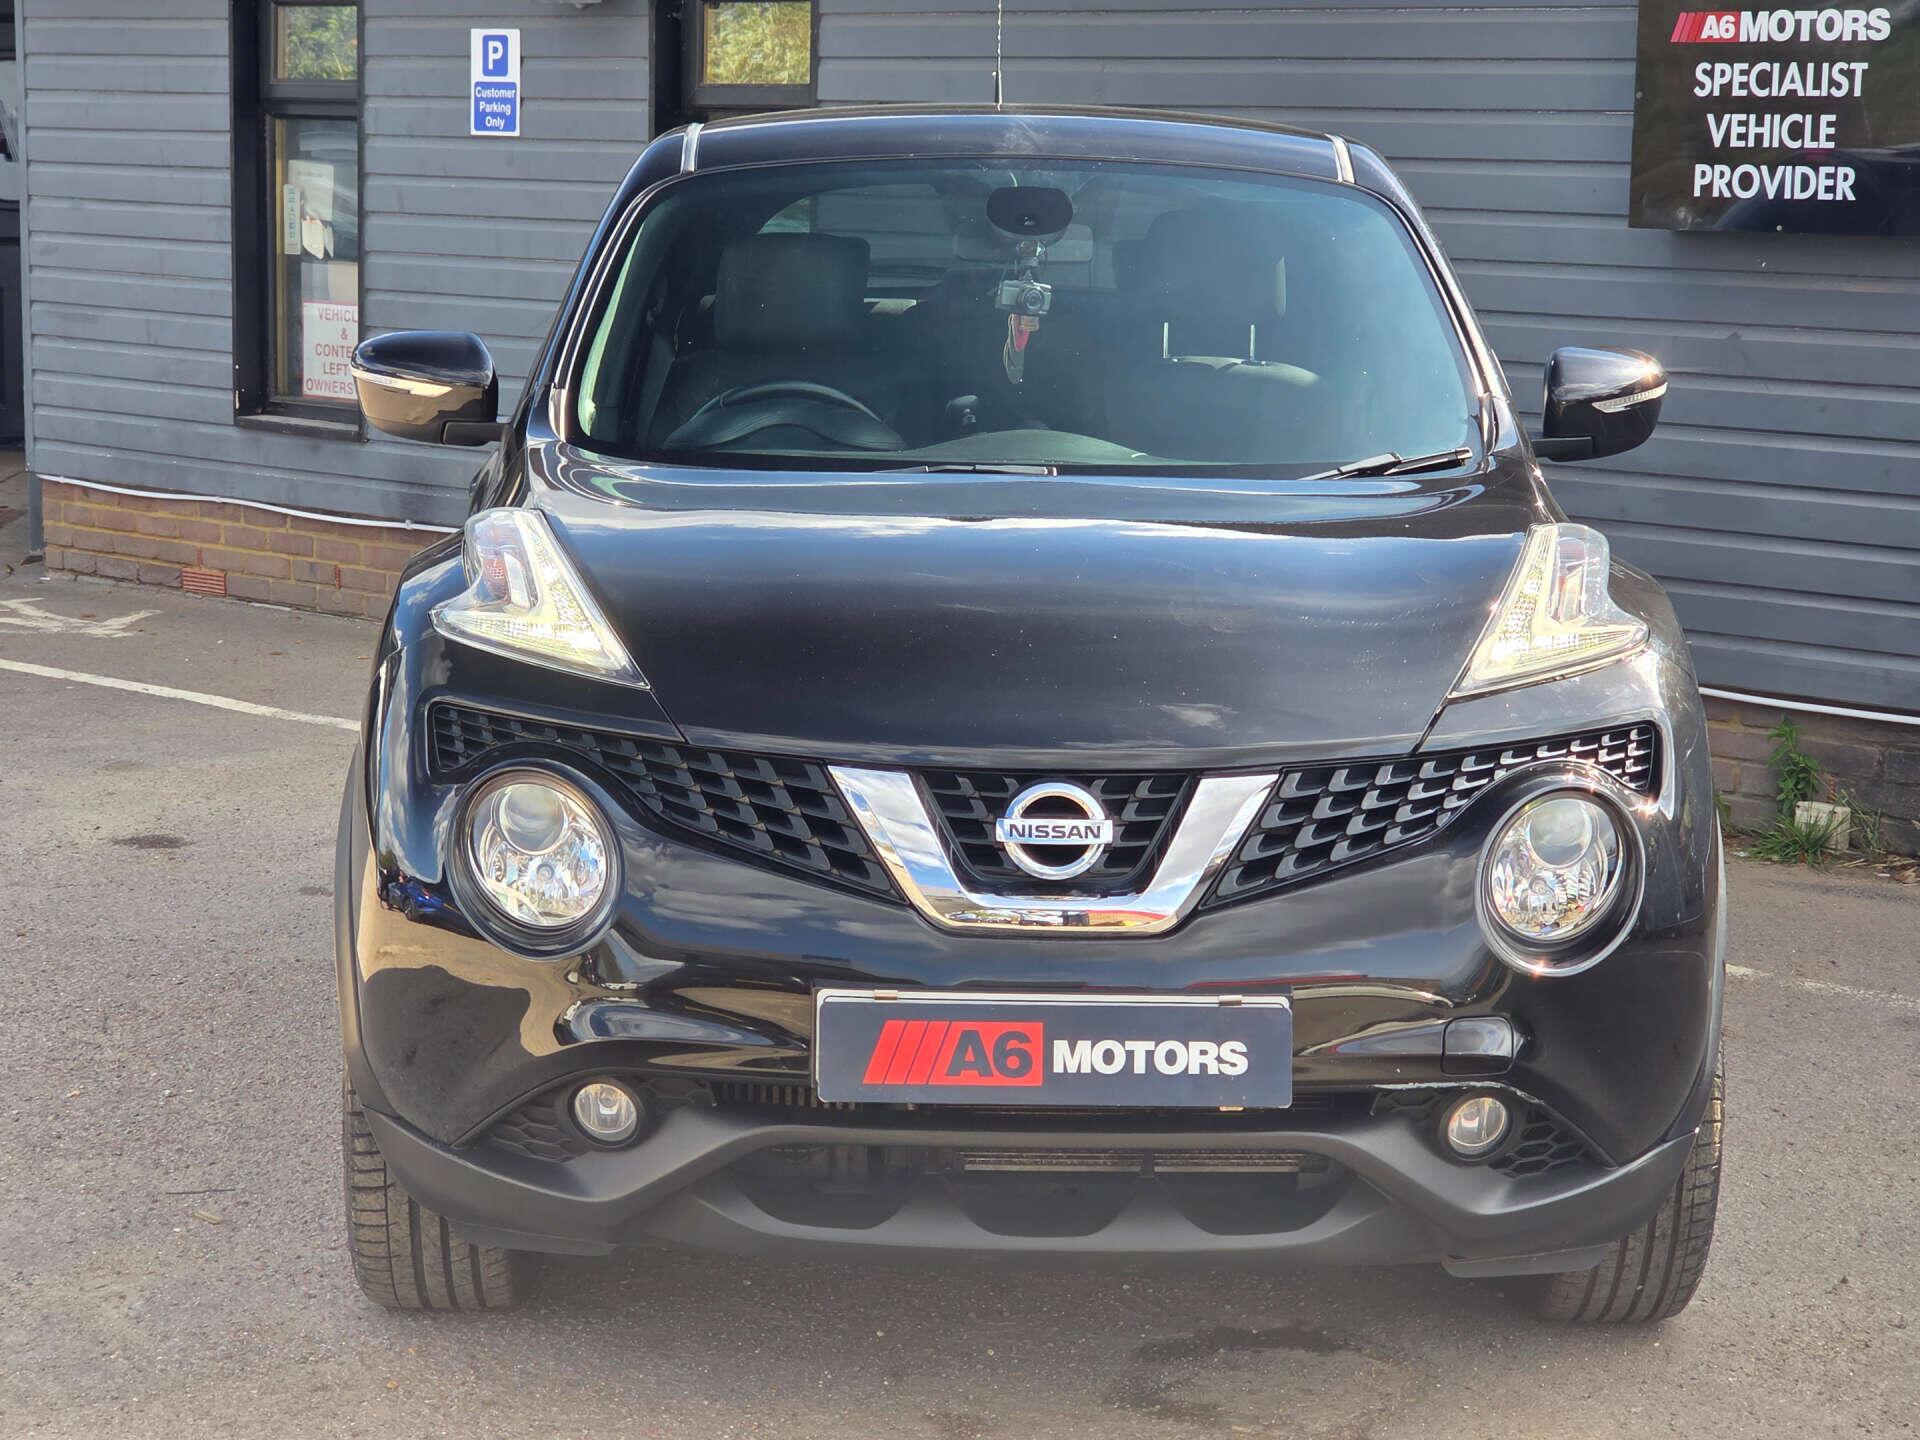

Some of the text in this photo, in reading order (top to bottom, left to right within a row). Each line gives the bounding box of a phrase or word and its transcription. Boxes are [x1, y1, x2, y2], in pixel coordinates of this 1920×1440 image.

[1701, 8, 1891, 42] A6 MOTORS
[488, 41, 504, 70] P
[1693, 61, 1868, 97] SPECIALIST
[475, 87, 515, 98] Customer
[480, 101, 511, 115] Parking
[485, 116, 505, 129] Only
[1706, 113, 1837, 149] VEHICLE
[1693, 164, 1856, 200] PROVIDER
[340, 327, 348, 340] &
[323, 361, 349, 377] LEFT
[306, 378, 353, 395] OWNERS
[1009, 824, 1101, 839] NISSAN
[945, 1029, 1249, 1078] A6 MOTORS
